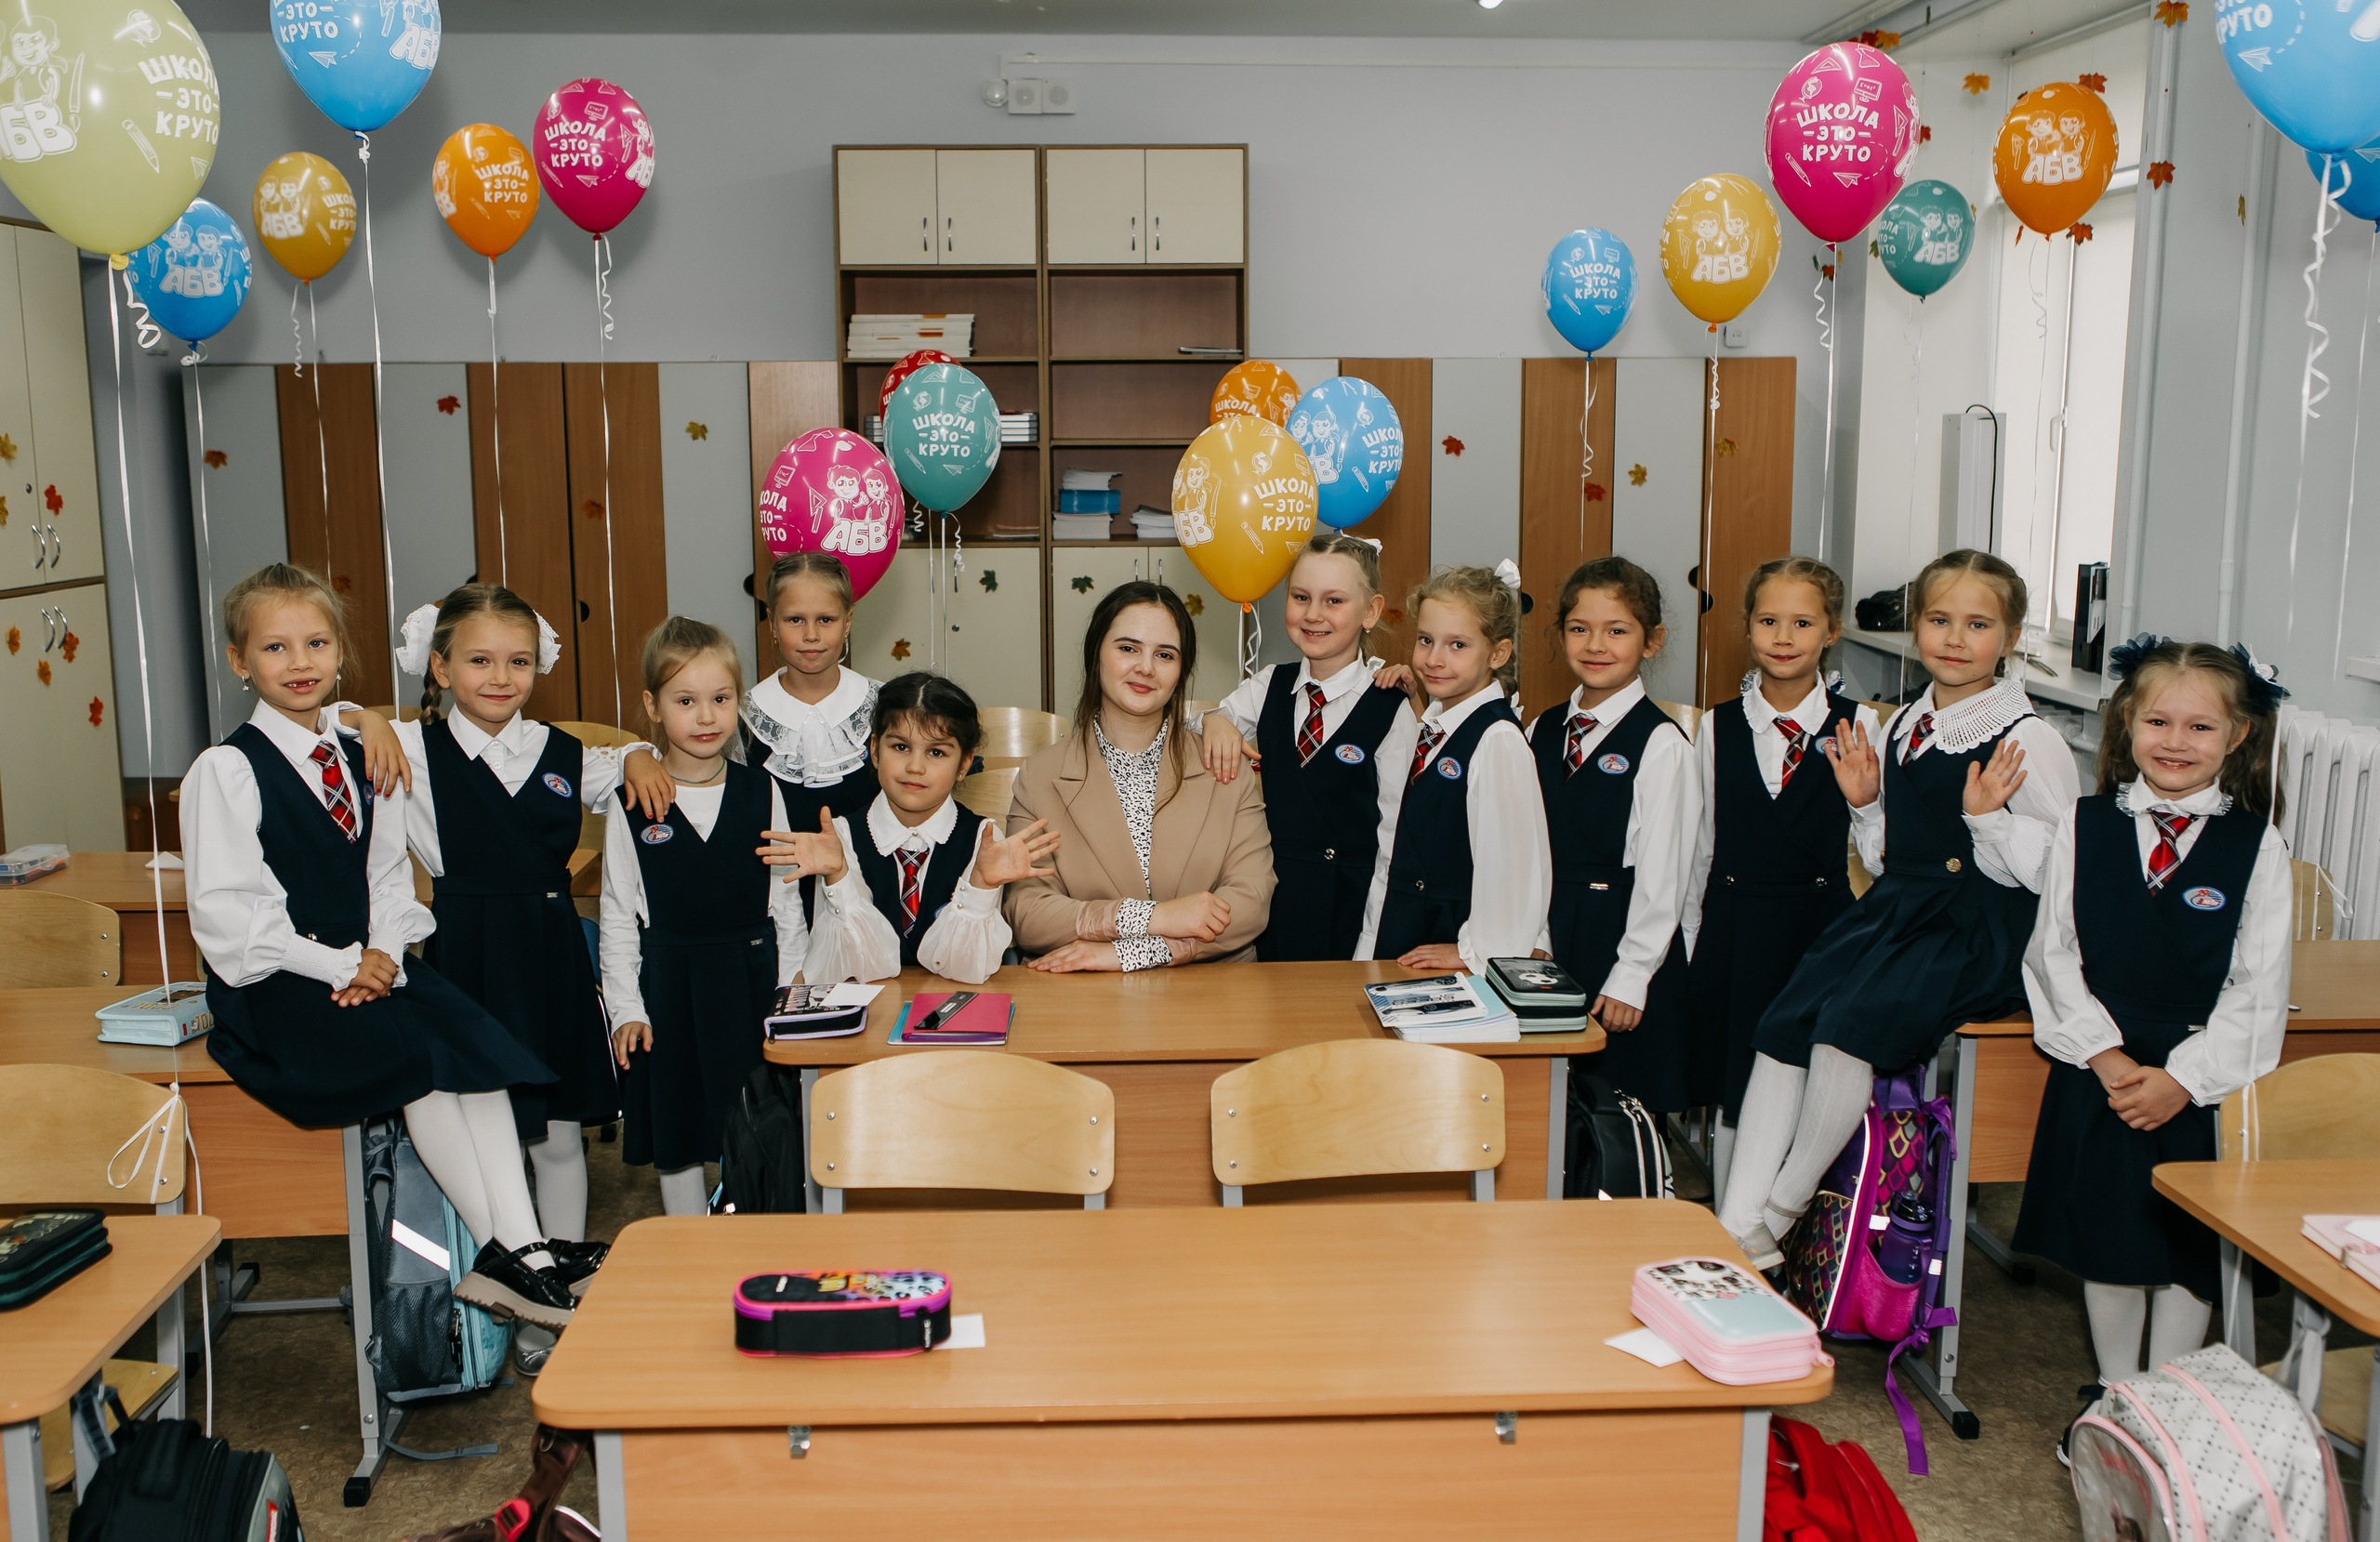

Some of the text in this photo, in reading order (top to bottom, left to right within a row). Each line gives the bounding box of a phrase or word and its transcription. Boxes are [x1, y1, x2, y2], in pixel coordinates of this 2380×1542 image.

[280, 20, 338, 44] КРУТО
[2217, 4, 2273, 45] РУТО
[1796, 102, 1879, 129] ШКОЛА
[155, 111, 218, 145] КРУТО
[544, 120, 606, 141] ШКОЛА
[550, 152, 604, 167] КРУТО
[1802, 144, 1871, 163] КРУТО
[475, 163, 530, 181] ШКОЛА
[2021, 153, 2083, 186] АБВ
[484, 191, 527, 204] КРУТО
[261, 212, 304, 239] АБВ
[1913, 241, 1960, 265] АБВ
[1569, 262, 1620, 279] ШКОЛА
[1691, 255, 1750, 283] АБВ
[159, 265, 224, 297] АБВ
[1575, 287, 1618, 299] КРУТО
[1215, 399, 1257, 415] ШКОЛА
[912, 413, 975, 434] ШКОЛА
[1361, 427, 1404, 448] ШКОЛ
[919, 442, 971, 457] КРУТО
[1254, 477, 1315, 501] ШКОЛА
[760, 489, 787, 512] КОЛА
[1262, 515, 1311, 532] КРУТО
[821, 517, 888, 556] АБВ
